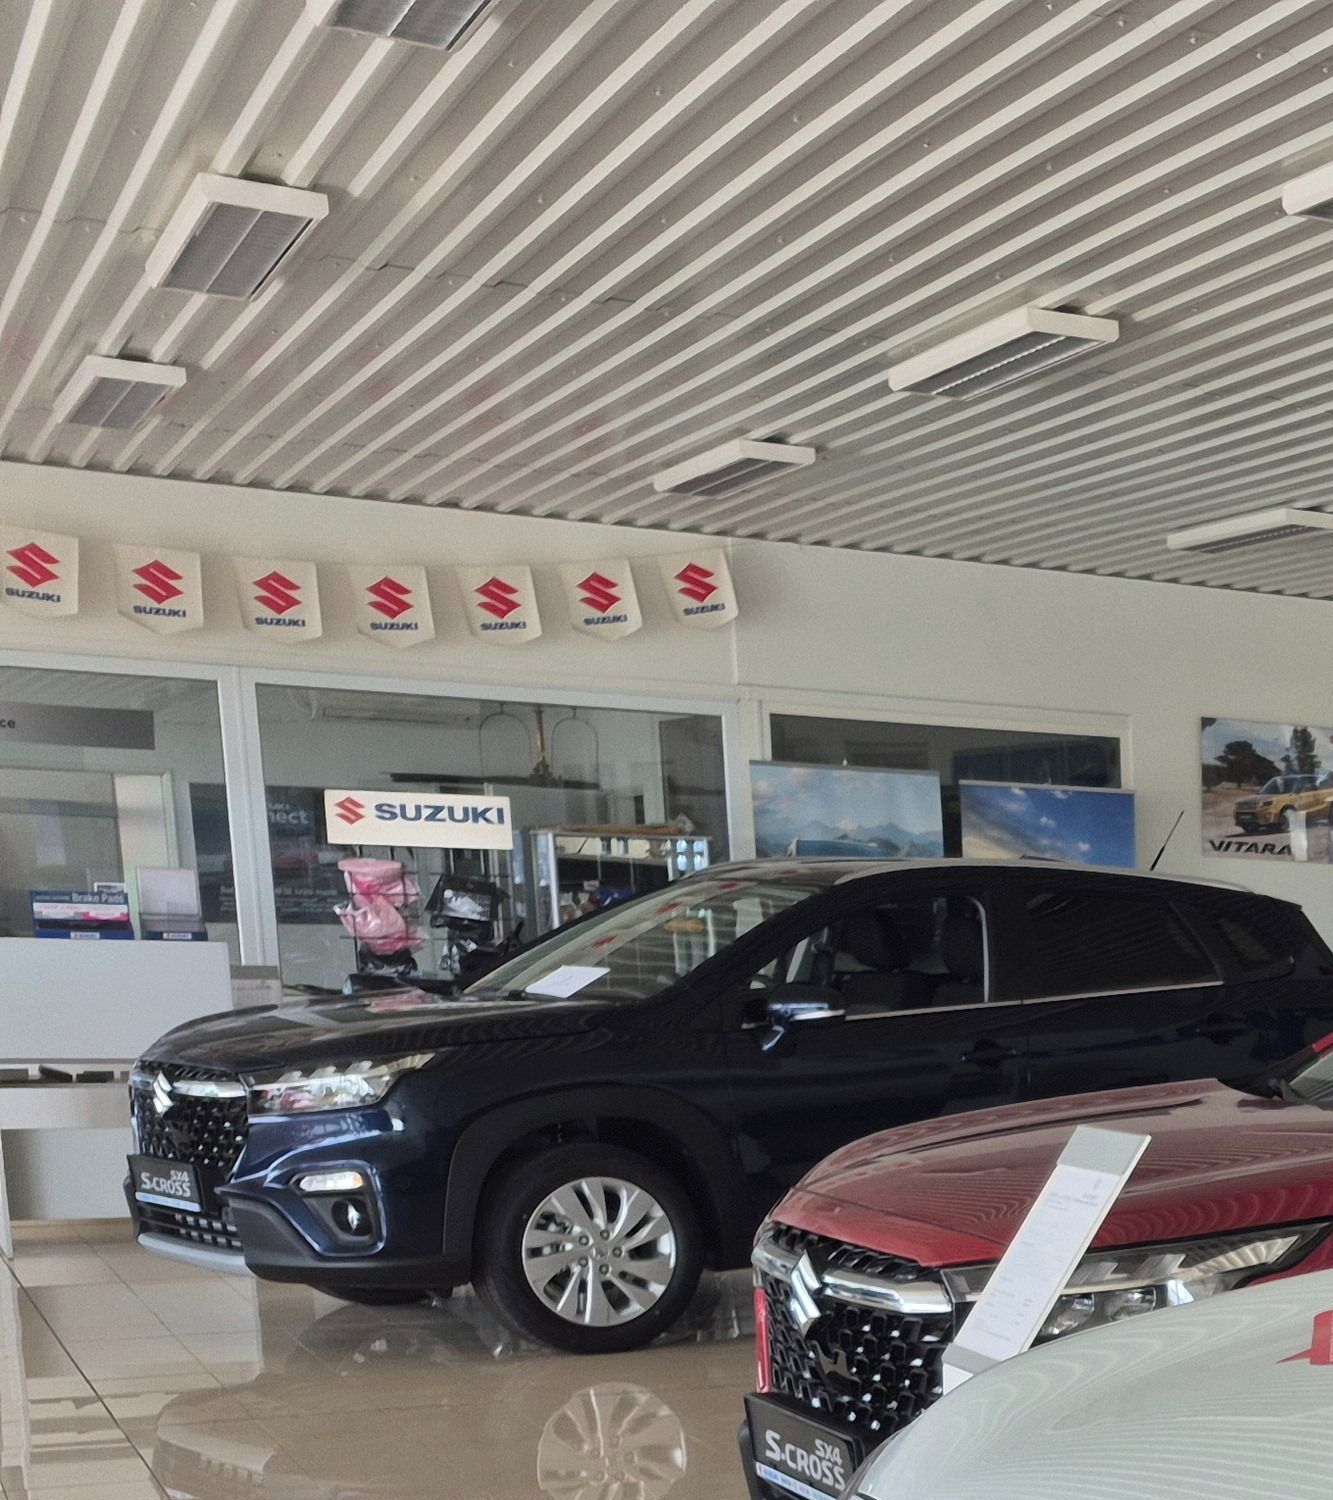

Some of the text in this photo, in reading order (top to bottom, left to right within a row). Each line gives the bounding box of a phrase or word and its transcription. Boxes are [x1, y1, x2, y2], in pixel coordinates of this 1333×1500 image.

[5, 587, 61, 603] SUZUKI
[132, 605, 187, 618] SUZUKI
[683, 602, 725, 616] SUZUKI
[255, 617, 306, 628] SUZUKI
[370, 621, 418, 631] SUZUKI
[480, 621, 527, 631] SUZUKI
[584, 614, 628, 626] SUZUKI
[374, 802, 505, 825] SUZUKI
[1209, 839, 1292, 856] VITARA
[170, 1169, 190, 1182] SX4
[815, 1438, 843, 1466] SX4
